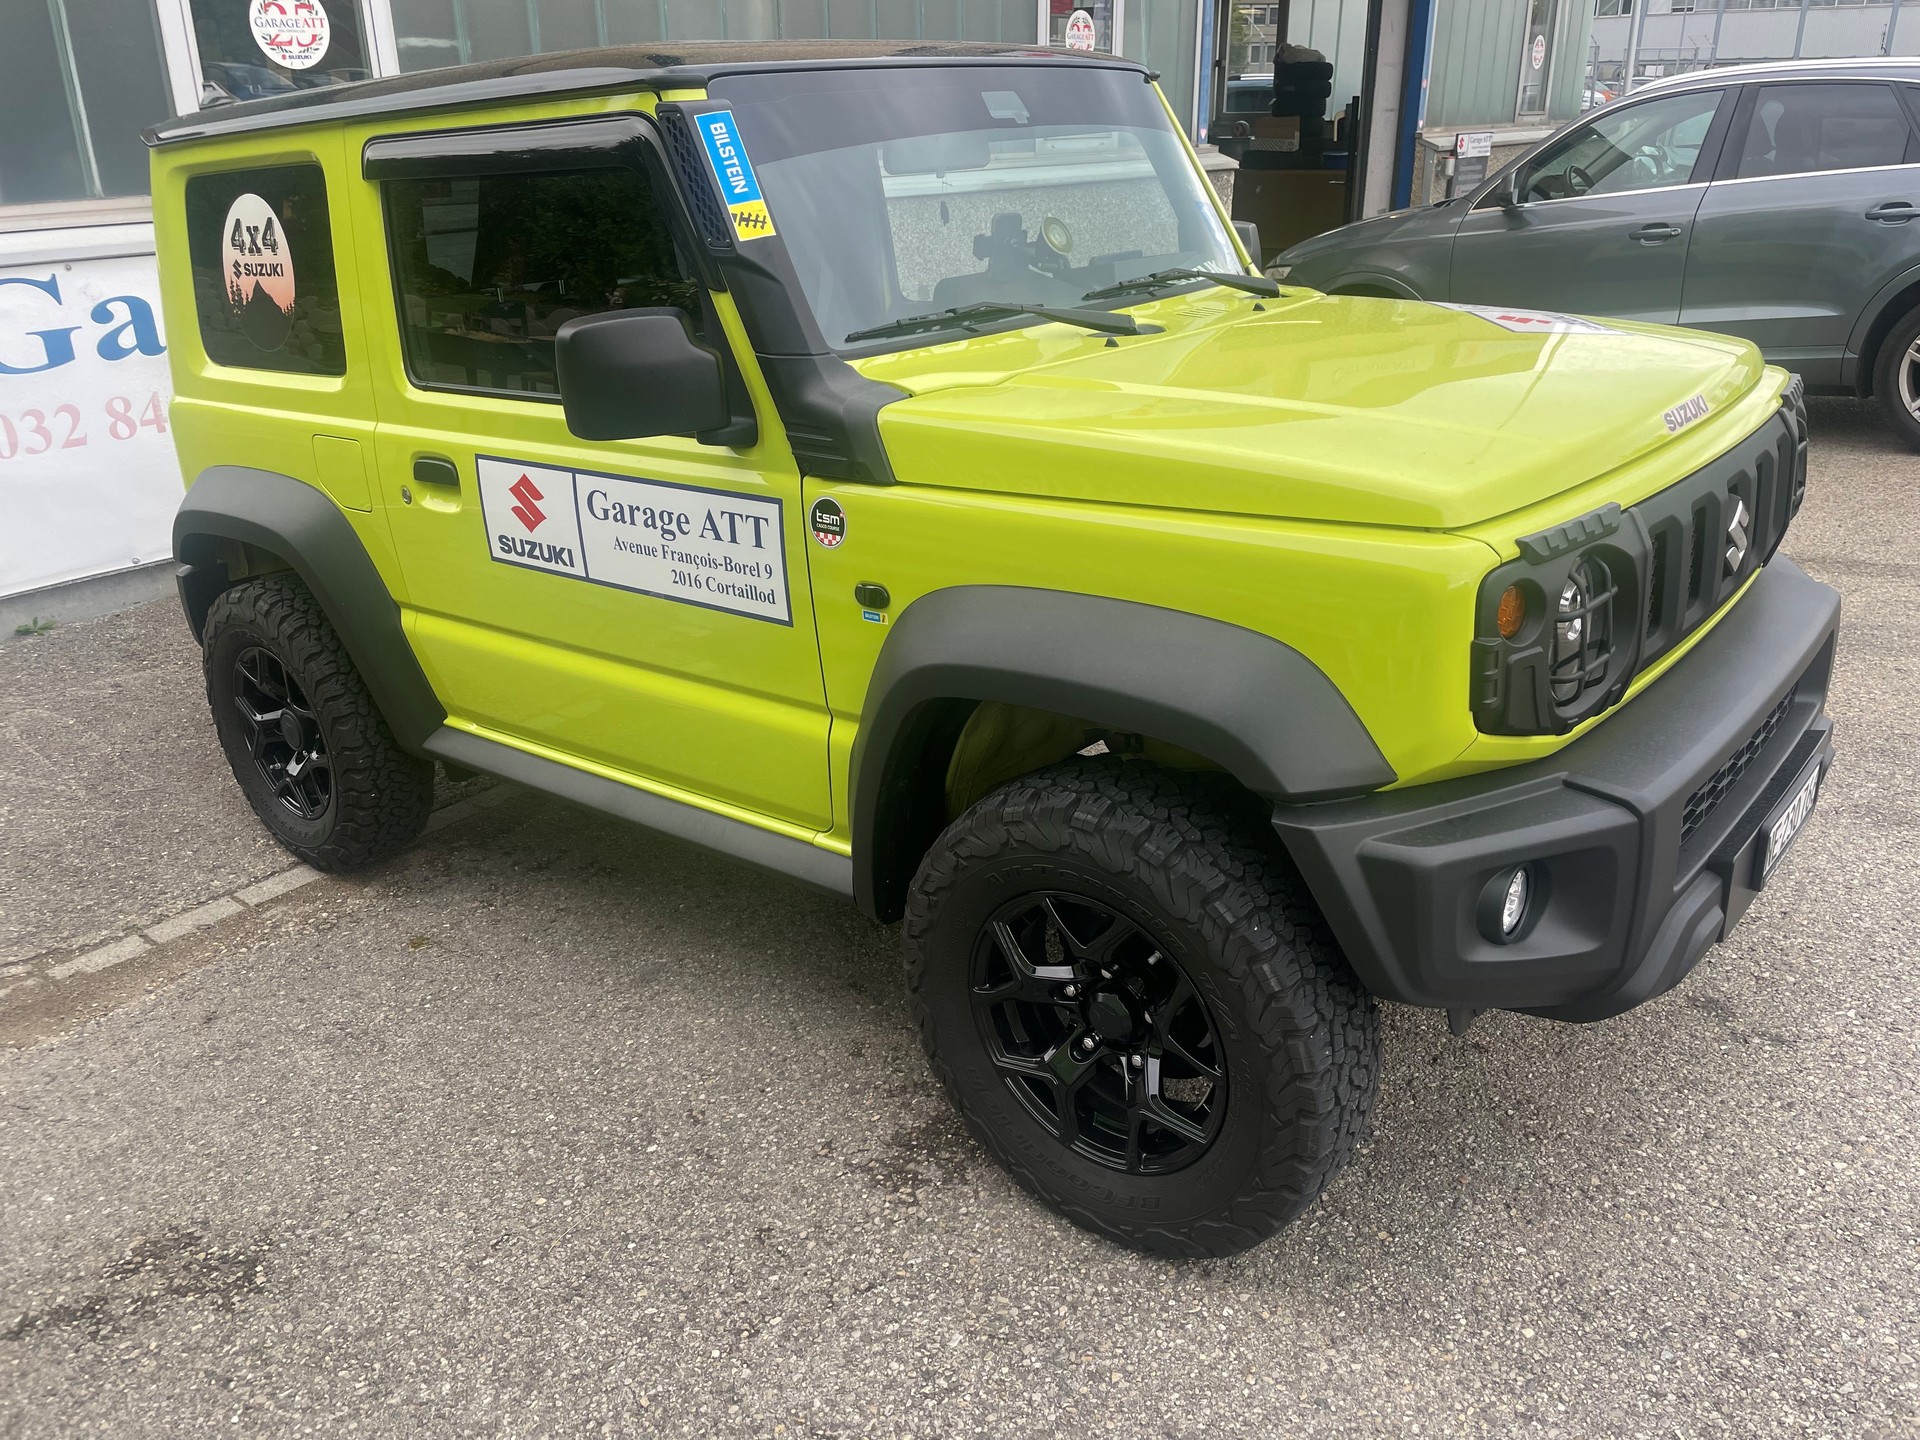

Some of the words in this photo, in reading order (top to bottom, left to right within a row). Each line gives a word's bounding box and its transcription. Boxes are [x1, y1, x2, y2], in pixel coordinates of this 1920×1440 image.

[709, 122, 749, 194] BILSTEIN
[243, 263, 284, 277] SUZUKI
[104, 390, 168, 441] 84
[1664, 395, 1709, 432] SUZUKI
[586, 489, 691, 541] Garage
[698, 508, 769, 549] ATT
[816, 509, 840, 526] tsm
[497, 534, 575, 568] SUZUKI
[613, 536, 658, 558] Avenue
[661, 544, 760, 578] François-Borel
[764, 563, 773, 580] 9
[670, 569, 702, 590] 2016
[705, 577, 777, 605] Cortaillod
